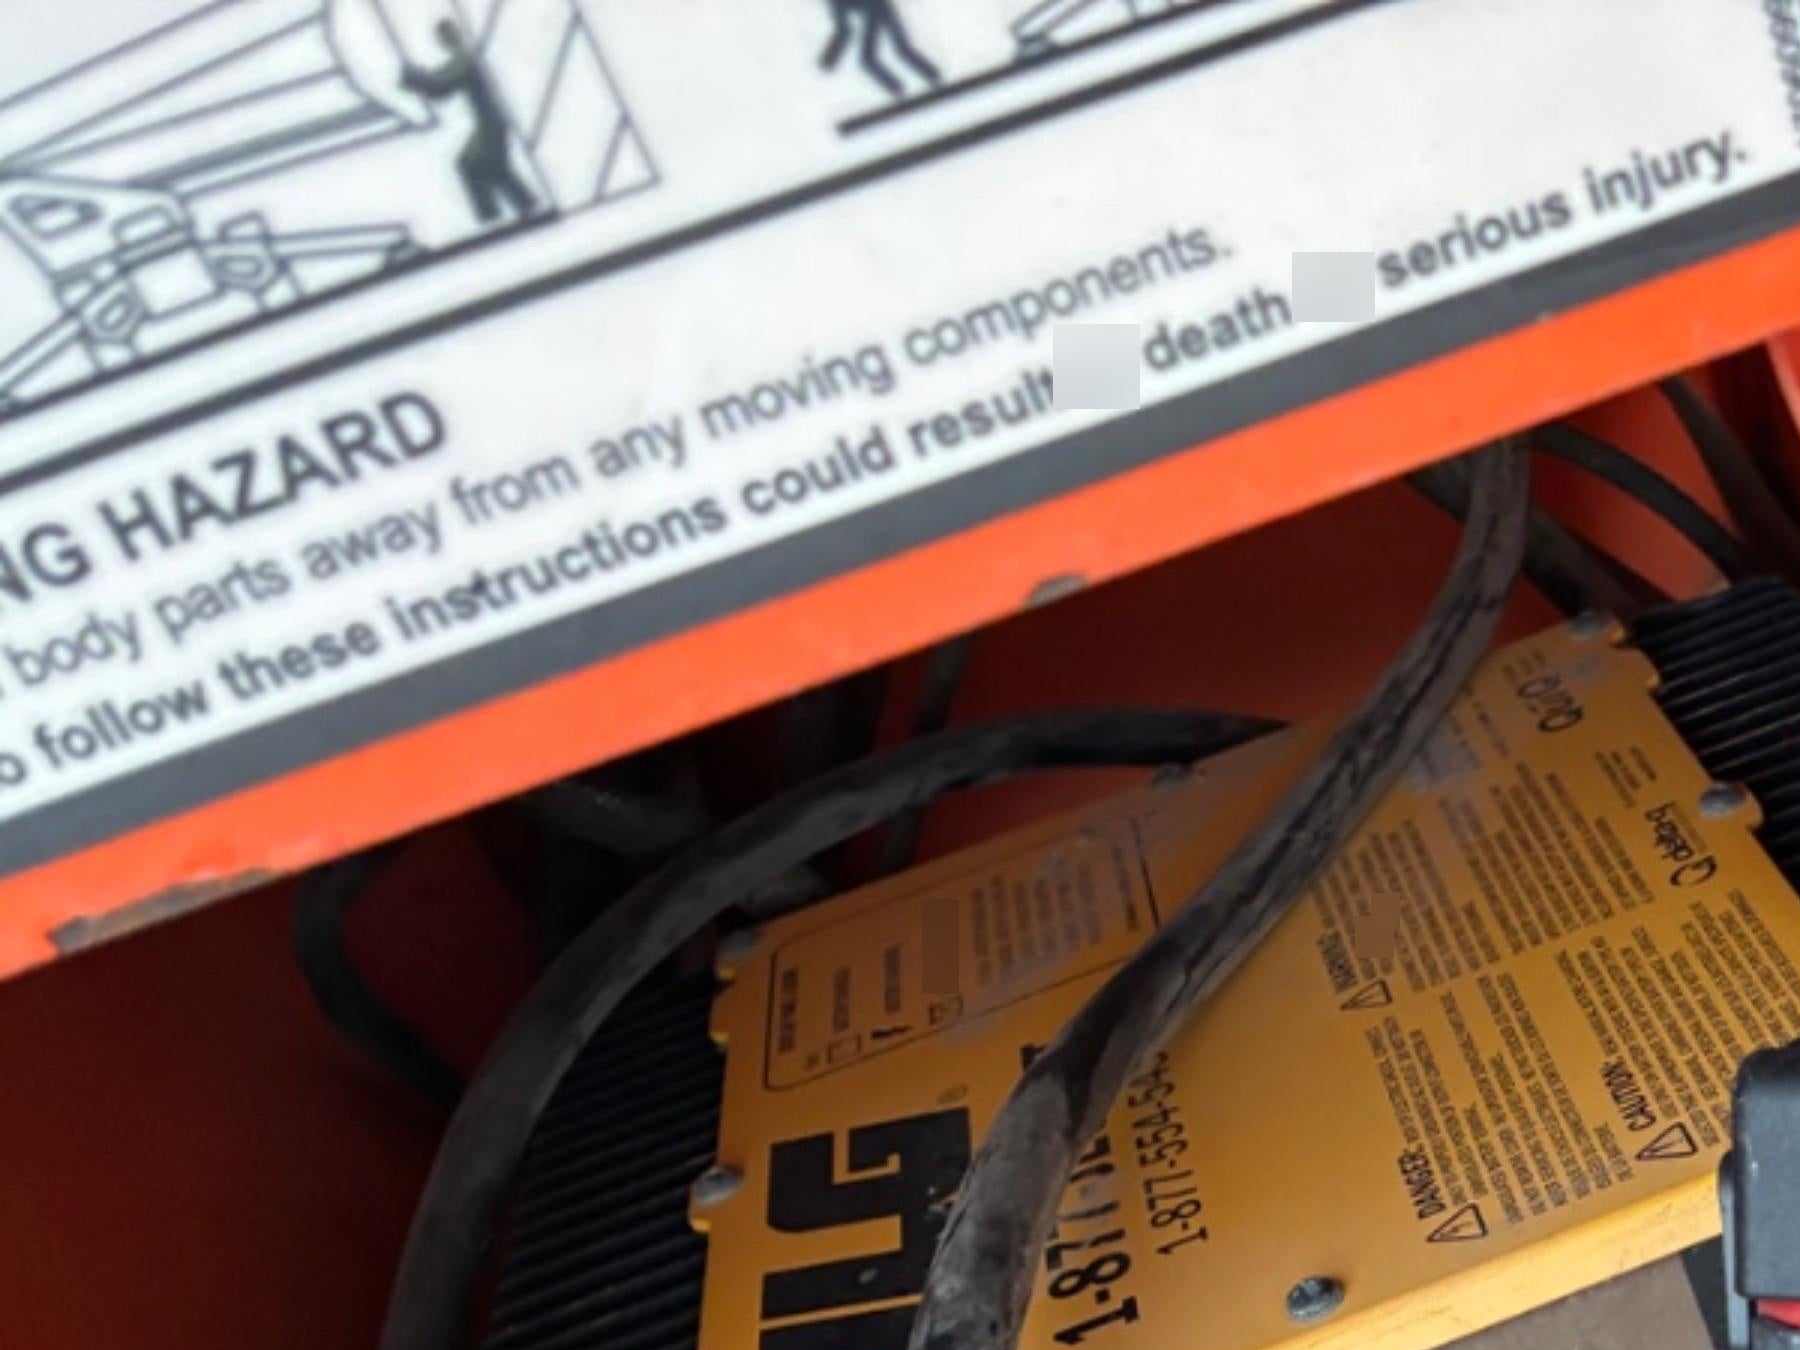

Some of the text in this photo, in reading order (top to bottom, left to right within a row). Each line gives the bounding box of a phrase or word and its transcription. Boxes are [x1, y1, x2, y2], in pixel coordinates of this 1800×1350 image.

[9, 222, 1233, 690] body parts away from any moving components.
[35, 686, 210, 769] follow
[218, 615, 380, 704] these
[397, 503, 728, 642] instructions
[742, 428, 897, 519] could
[908, 367, 1056, 461] result
[1143, 285, 1291, 374] death
[1376, 184, 1572, 288] serious
[1583, 129, 1748, 223] injury.
[98, 391, 447, 561] HAZARD
